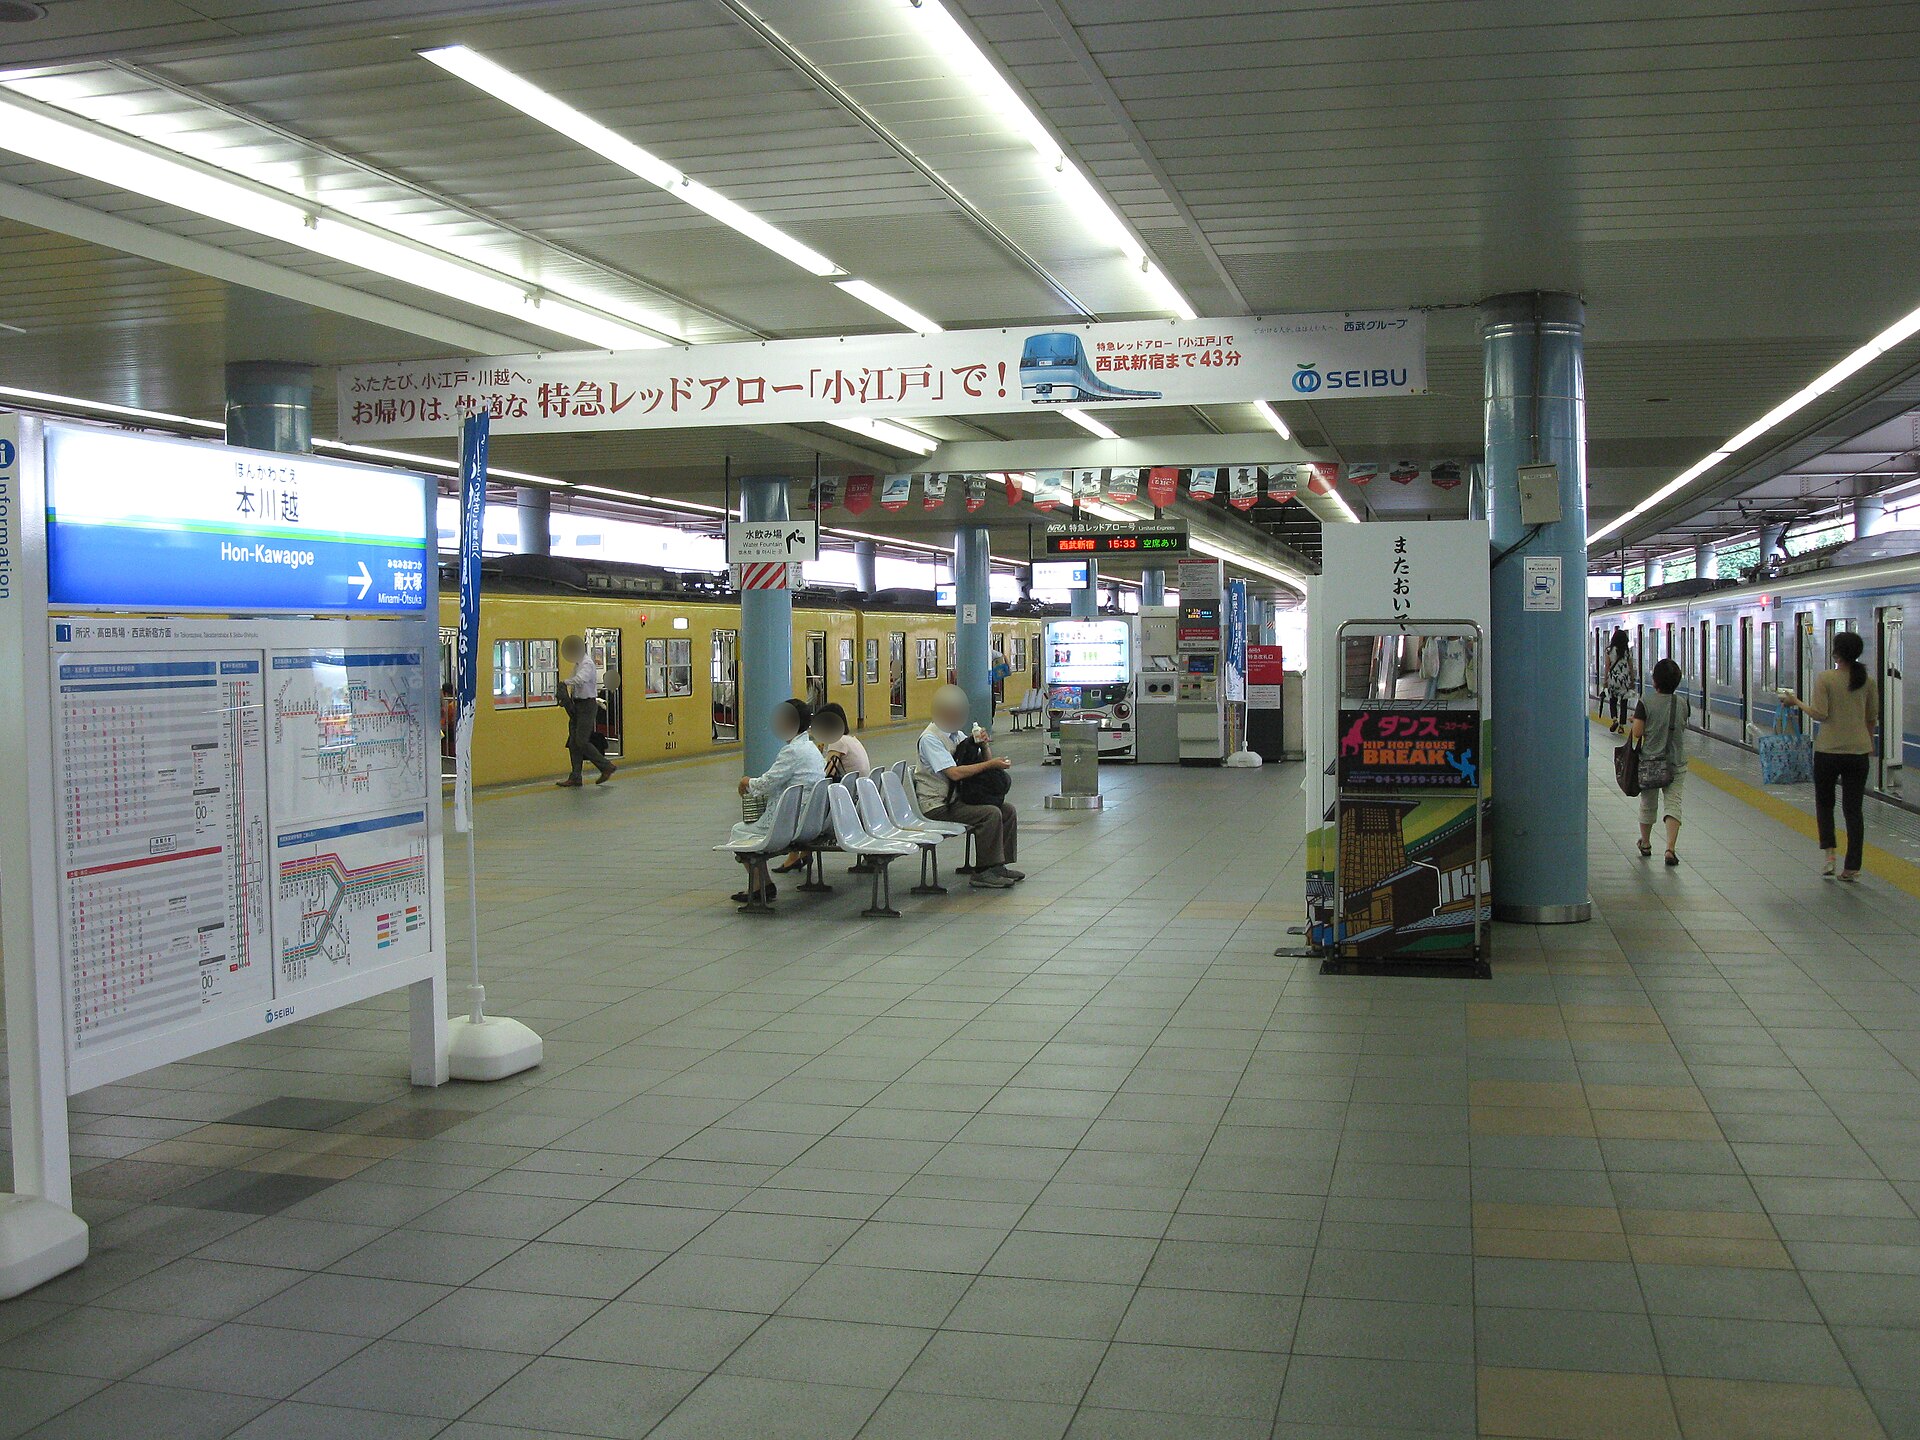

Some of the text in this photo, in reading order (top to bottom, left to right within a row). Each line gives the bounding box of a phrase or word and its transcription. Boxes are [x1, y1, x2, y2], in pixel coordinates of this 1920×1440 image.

[1344, 319, 1408, 332] 西武グループ
[1096, 335, 1234, 351] 特急レッドアロー「小江戸」で
[1095, 349, 1242, 372] 西武新宿まで43分
[351, 368, 533, 393] ふたたび、小江戸・川越へ。
[1326, 368, 1408, 389] SEIBU
[538, 361, 1008, 420] 特急レッドアロー「小江戸」で！
[235, 461, 298, 485] ほんかわごえ
[236, 485, 299, 523] 本川越
[745, 529, 783, 540] 水飲み場
[1069, 523, 1136, 532] 特急レッドアロー号
[0, 476, 12, 599] Information
[1060, 538, 1178, 549] 西武新宿 15:33 空席あり
[221, 541, 315, 570] Hon-Kawagoe
[387, 559, 423, 570] みなみおおつか
[393, 571, 423, 591] 南大塚
[1074, 571, 1081, 581] 3
[378, 591, 423, 605] Minami-Ōtsuka
[63, 627, 69, 640] 1
[75, 627, 172, 639] 所沢・高田馬場・西武新宿方面
[1378, 716, 1439, 736] ダンス
[1363, 741, 1455, 750] HIP HOP HOUSE
[1363, 749, 1446, 765] BREAK
[274, 1005, 295, 1021] SEIBU
